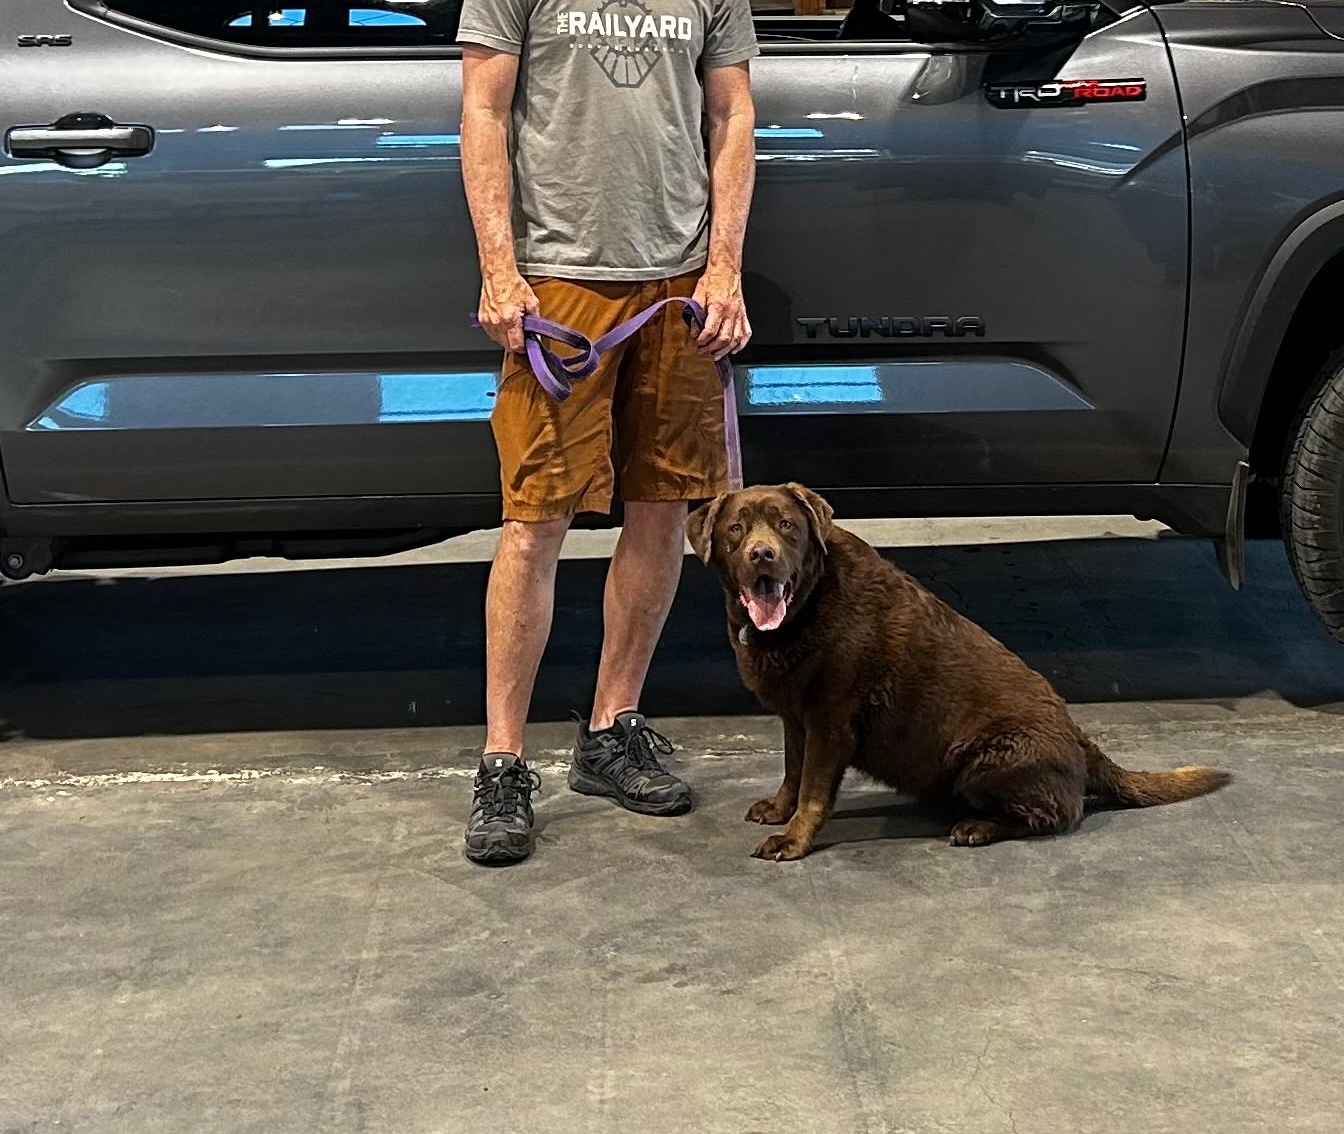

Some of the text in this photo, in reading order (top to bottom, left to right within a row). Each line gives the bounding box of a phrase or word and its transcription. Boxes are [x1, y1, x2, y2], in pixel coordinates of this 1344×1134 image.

[556, 12, 568, 35] THE
[569, 11, 692, 40] RAILYARD
[990, 81, 1062, 104] TRD
[1073, 86, 1142, 99] ROAD
[797, 315, 987, 339] TUNDRA
